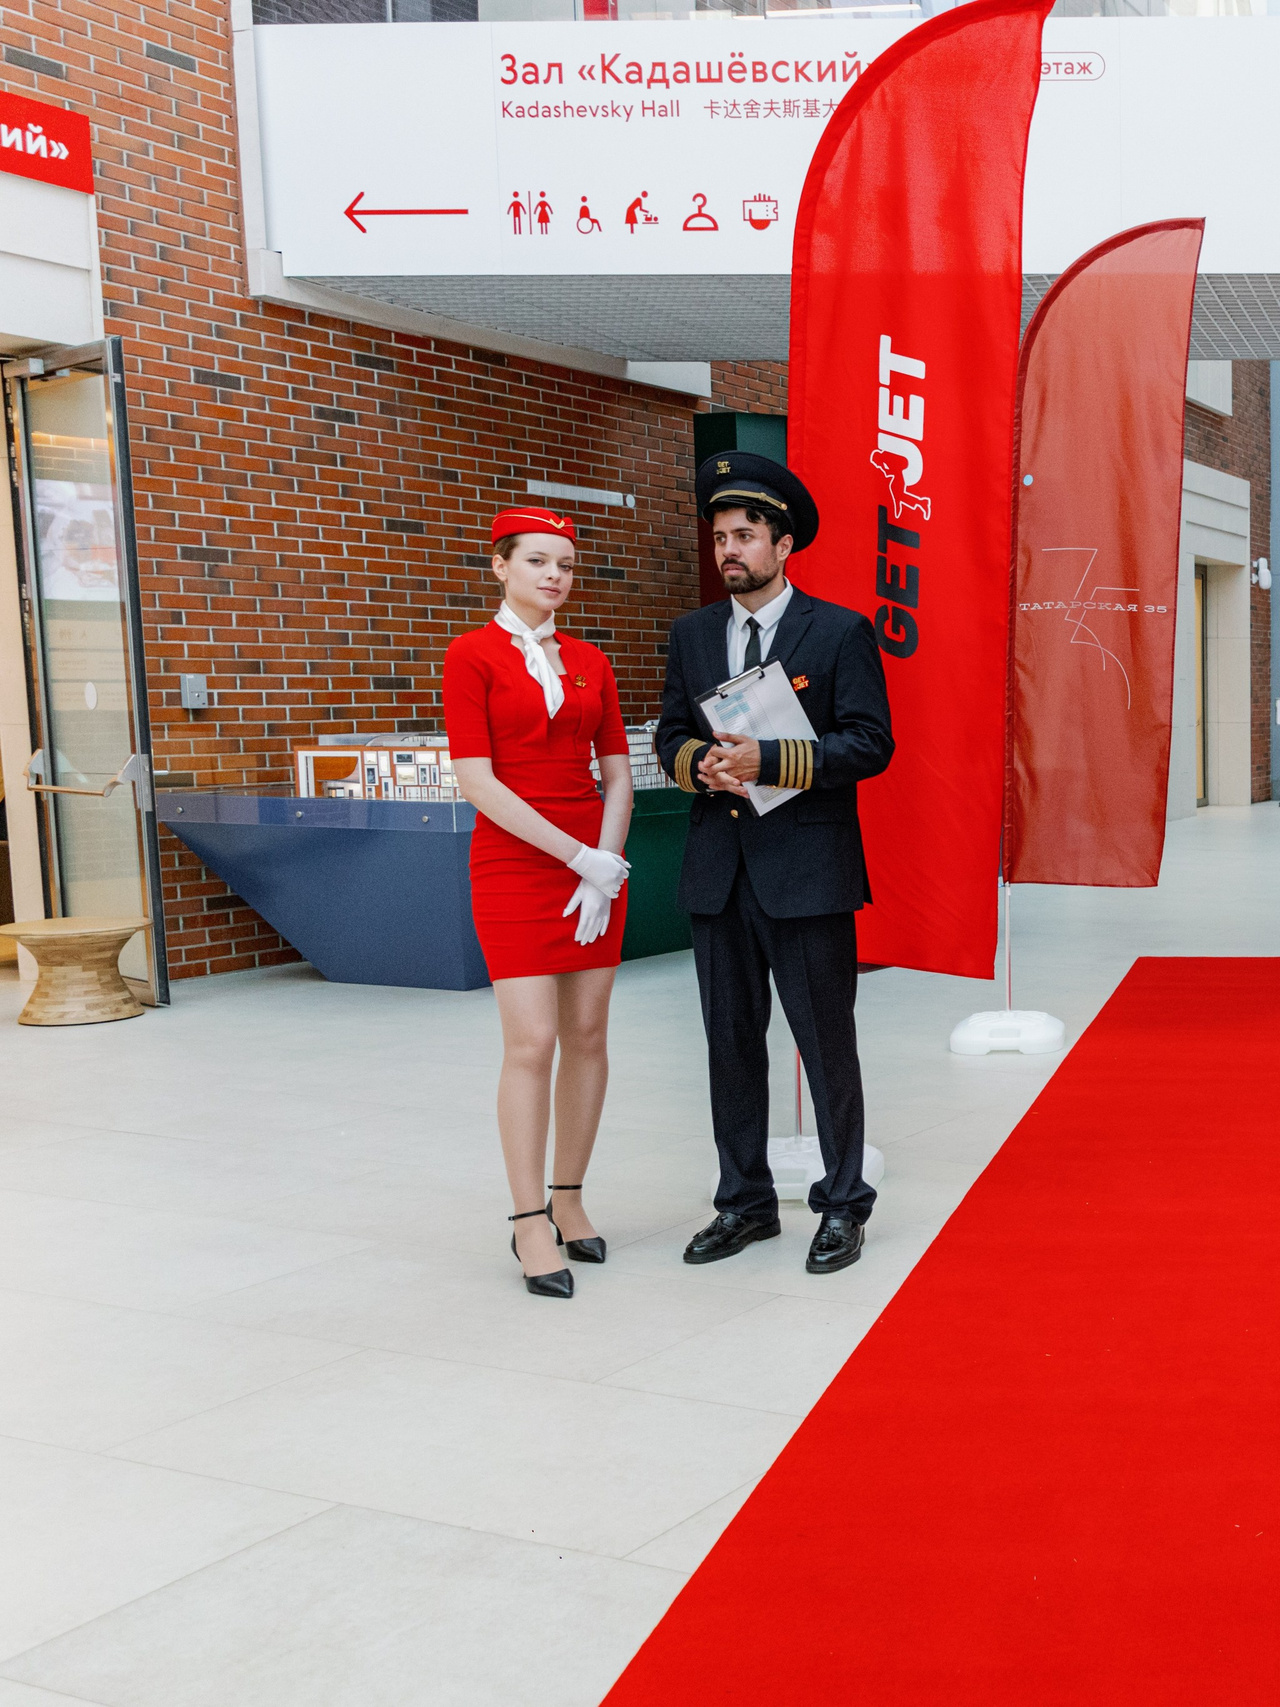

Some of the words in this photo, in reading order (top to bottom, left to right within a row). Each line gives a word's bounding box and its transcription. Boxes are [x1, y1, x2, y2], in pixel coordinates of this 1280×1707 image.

[500, 53, 563, 85] Зал
[577, 51, 871, 89] «Кадашёвский
[501, 100, 634, 122] Kadashevsky
[641, 100, 680, 118] Hall
[877, 334, 926, 487] JET
[874, 504, 921, 659] GET
[1019, 601, 1138, 612] ТАТАРСКАЯ
[1144, 605, 1167, 613] 35
